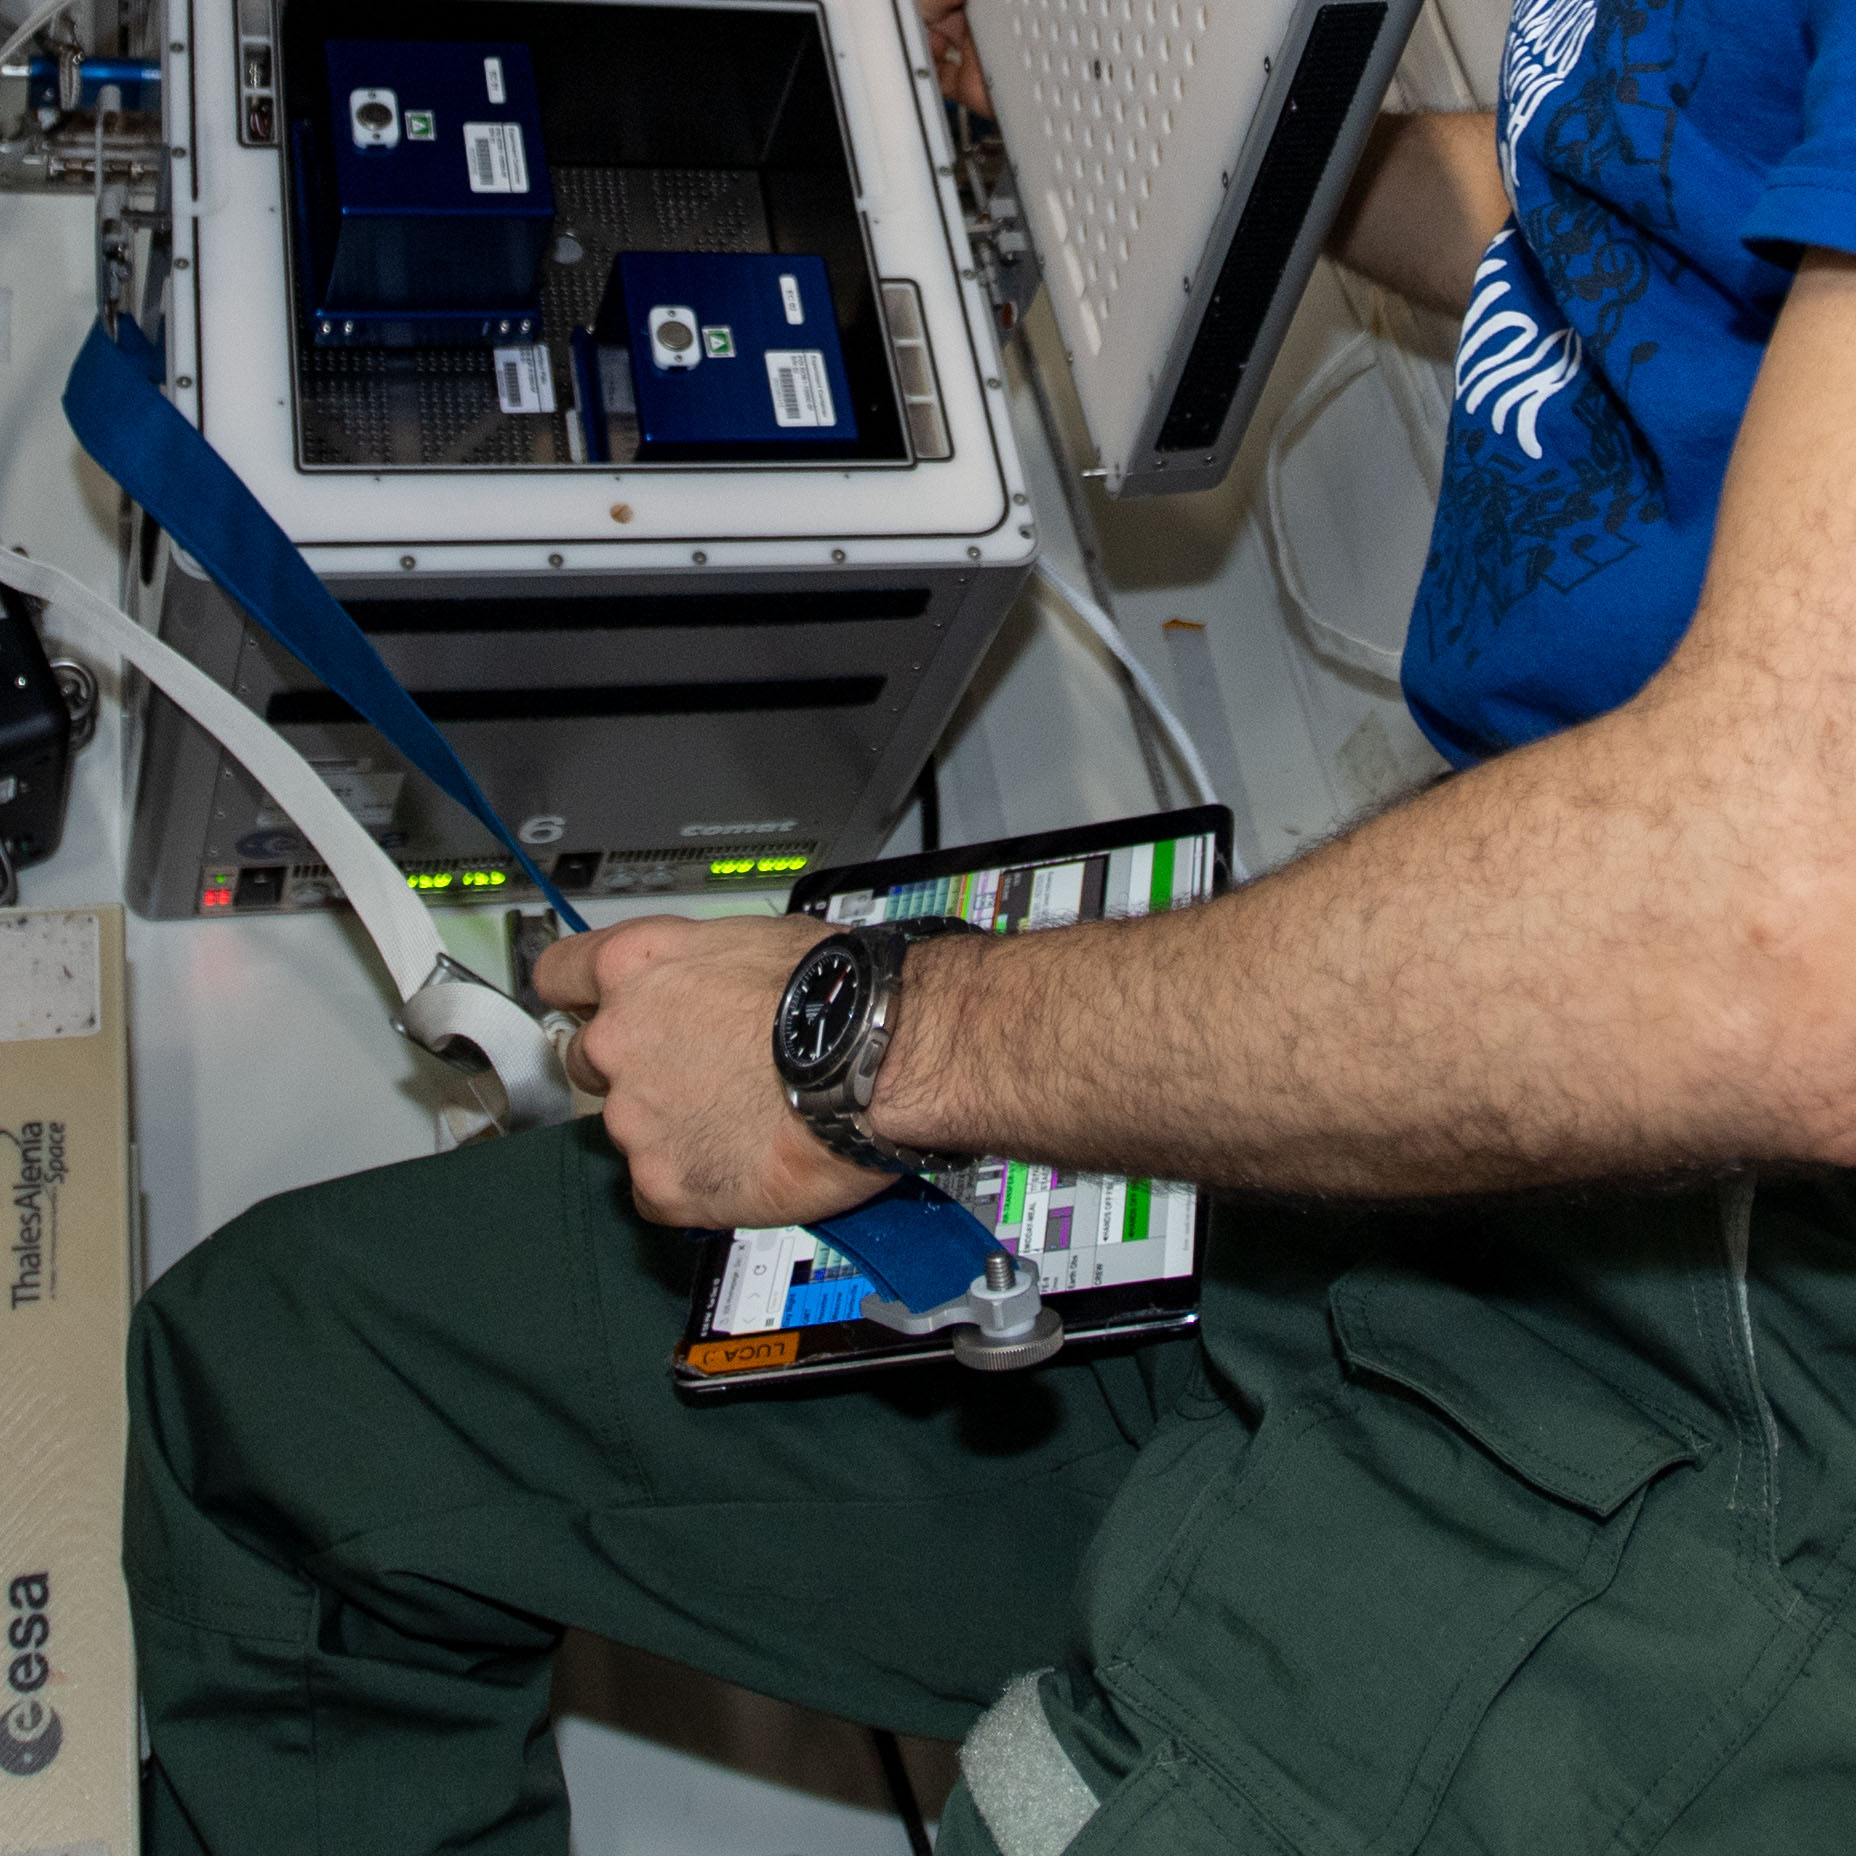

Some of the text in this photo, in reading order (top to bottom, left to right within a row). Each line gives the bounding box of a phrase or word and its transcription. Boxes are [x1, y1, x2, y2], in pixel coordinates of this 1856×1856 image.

[517, 815, 800, 846] 6 comet
[45, 1120, 67, 1185] Space
[11, 1120, 46, 1310] ThalesAlenia
[1095, 1264, 1103, 1285] CREW
[724, 1342, 786, 1363] LUCA
